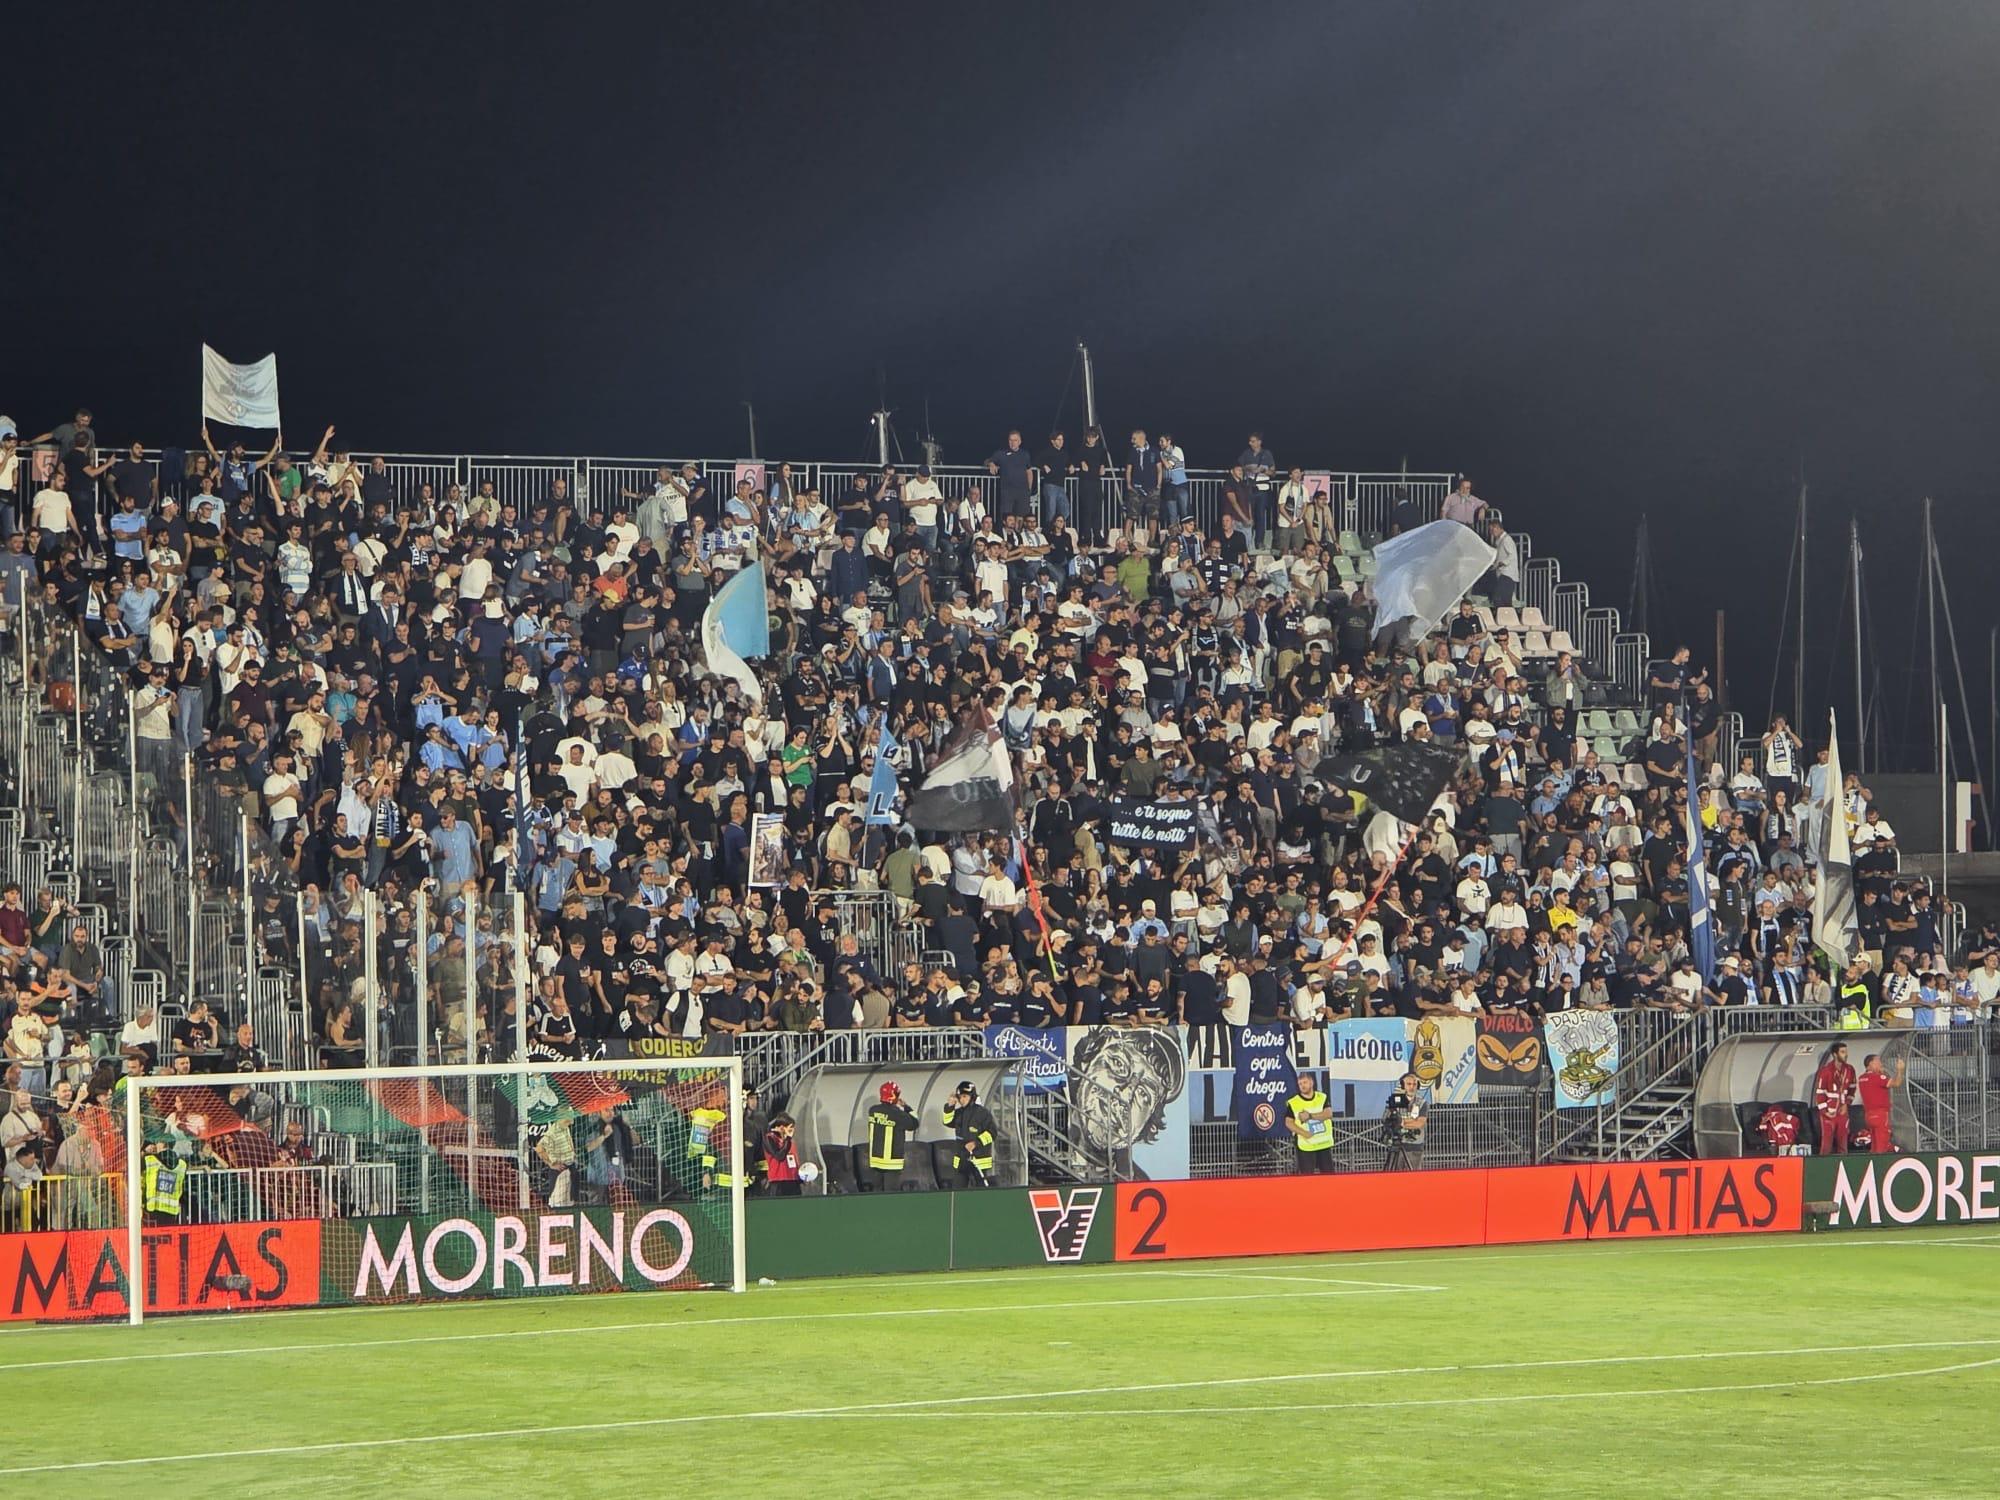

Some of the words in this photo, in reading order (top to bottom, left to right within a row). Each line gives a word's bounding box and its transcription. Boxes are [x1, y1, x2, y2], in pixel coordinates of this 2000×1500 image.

[743, 468, 756, 490] 6
[1310, 479, 1321, 501] 7
[1135, 806, 1144, 817] e
[1144, 805, 1156, 818] ti
[1156, 807, 1192, 823] sogno
[1111, 821, 1141, 839] tutte
[1142, 825, 1155, 840] le
[1483, 1014, 1535, 1033] DIABLO
[1550, 1009, 1587, 1028] DAJE
[1241, 1028, 1285, 1048] Contro
[1332, 1031, 1404, 1061] Lucone
[1250, 1055, 1282, 1079] ogni
[1246, 1077, 1287, 1102] droga
[1130, 1187, 1167, 1256] 2
[1562, 1163, 1779, 1235] MATIAS
[353, 1208, 694, 1297] MORENO
[10, 1227, 289, 1314] MATIAS
